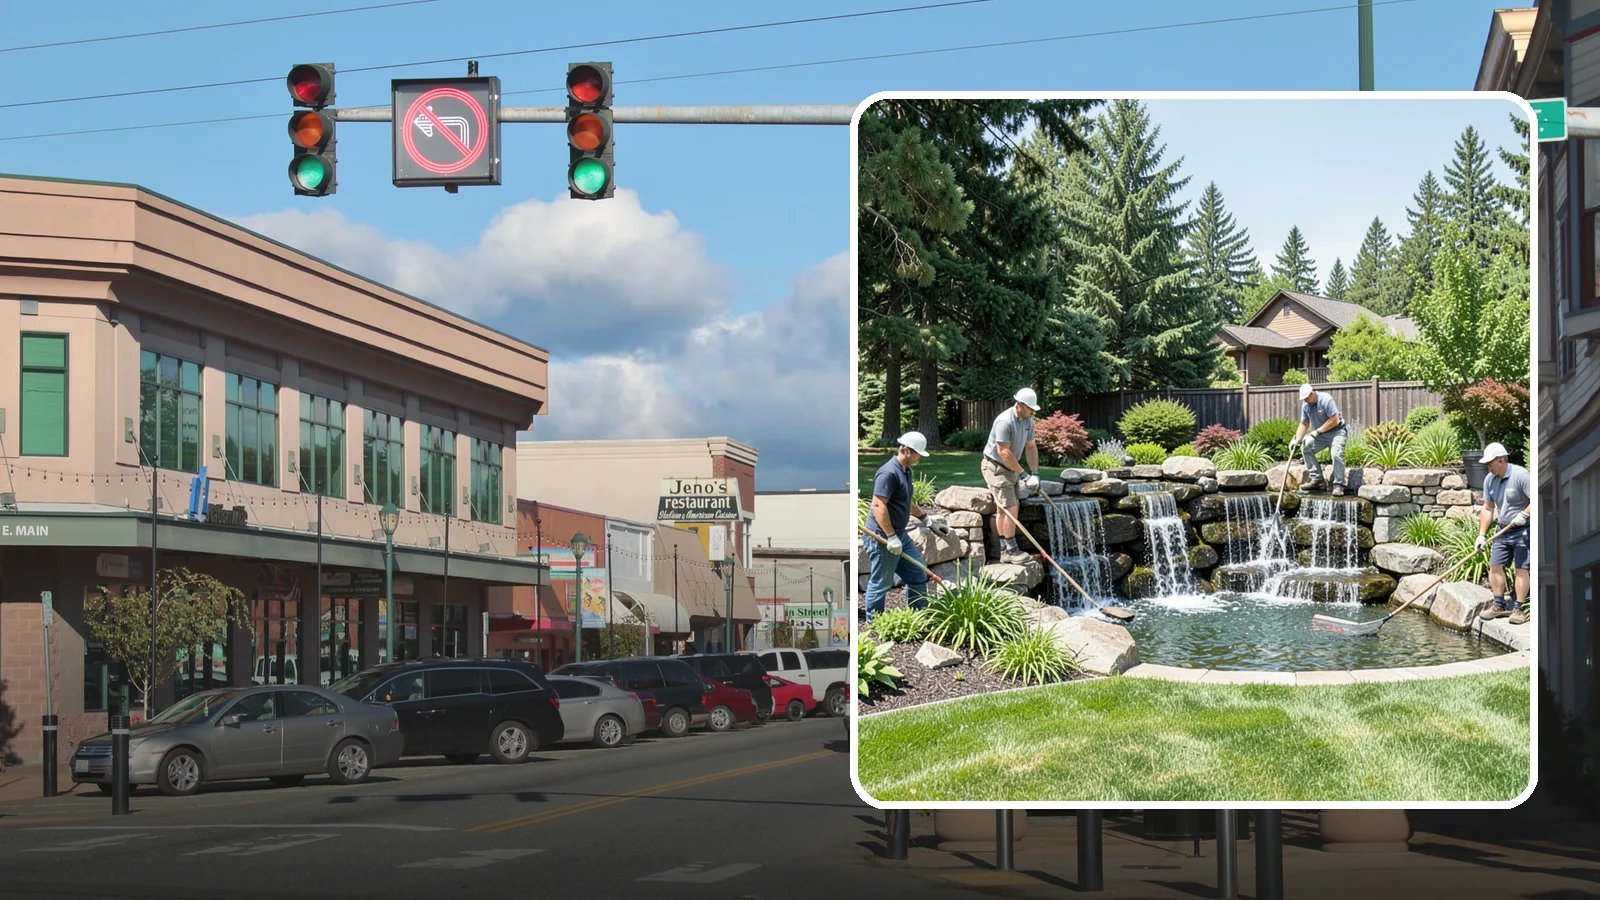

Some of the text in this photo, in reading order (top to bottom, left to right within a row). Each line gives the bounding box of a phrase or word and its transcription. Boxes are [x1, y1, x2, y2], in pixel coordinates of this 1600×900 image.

[670, 480, 728, 495] Jeno's
[665, 496, 731, 509] restaurant
[659, 510, 682, 520] Italian
[686, 510, 715, 519] American
[715, 510, 738, 519] Cuisine
[2, 525, 49, 536] E. MAIN
[797, 607, 829, 617] Street
